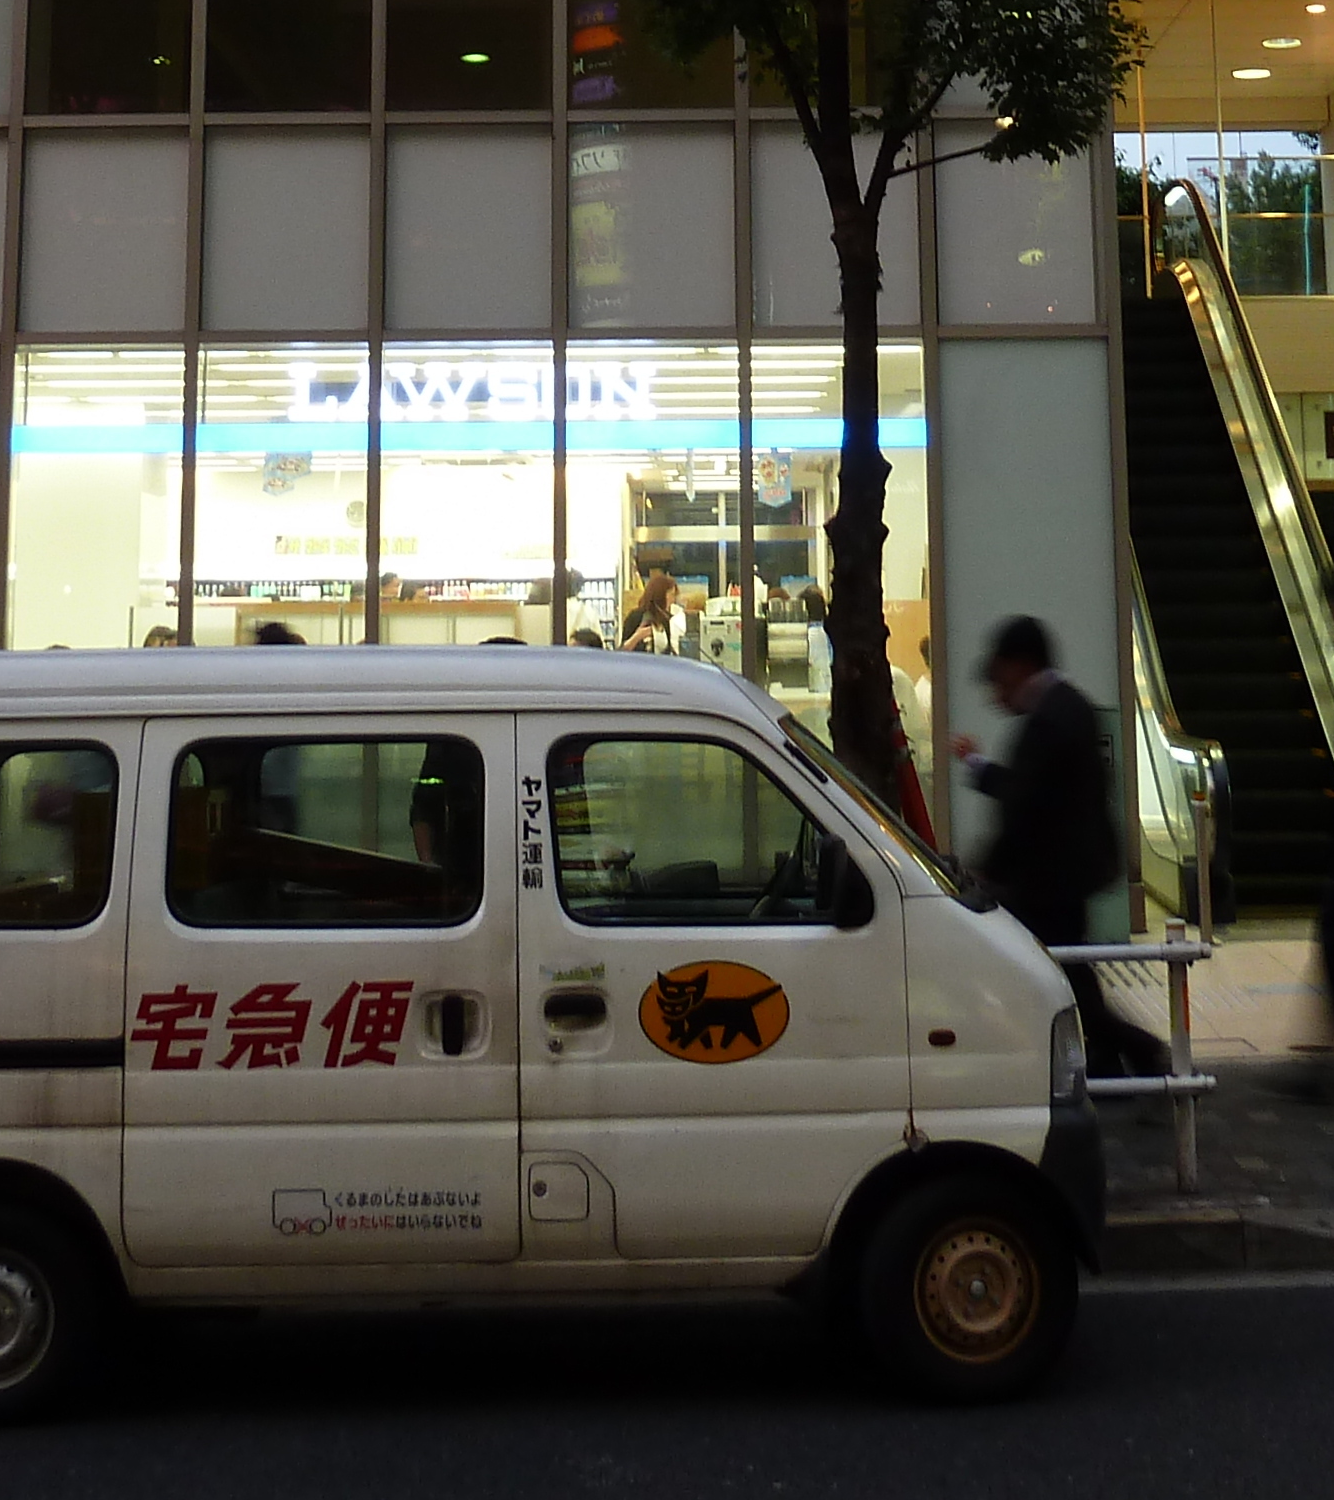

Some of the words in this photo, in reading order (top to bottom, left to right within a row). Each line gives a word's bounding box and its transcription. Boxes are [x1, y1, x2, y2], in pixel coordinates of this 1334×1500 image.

[287, 361, 658, 422] LAWSON
[521, 775, 544, 890] ヤマト運輸
[129, 980, 415, 1071] 宅急便
